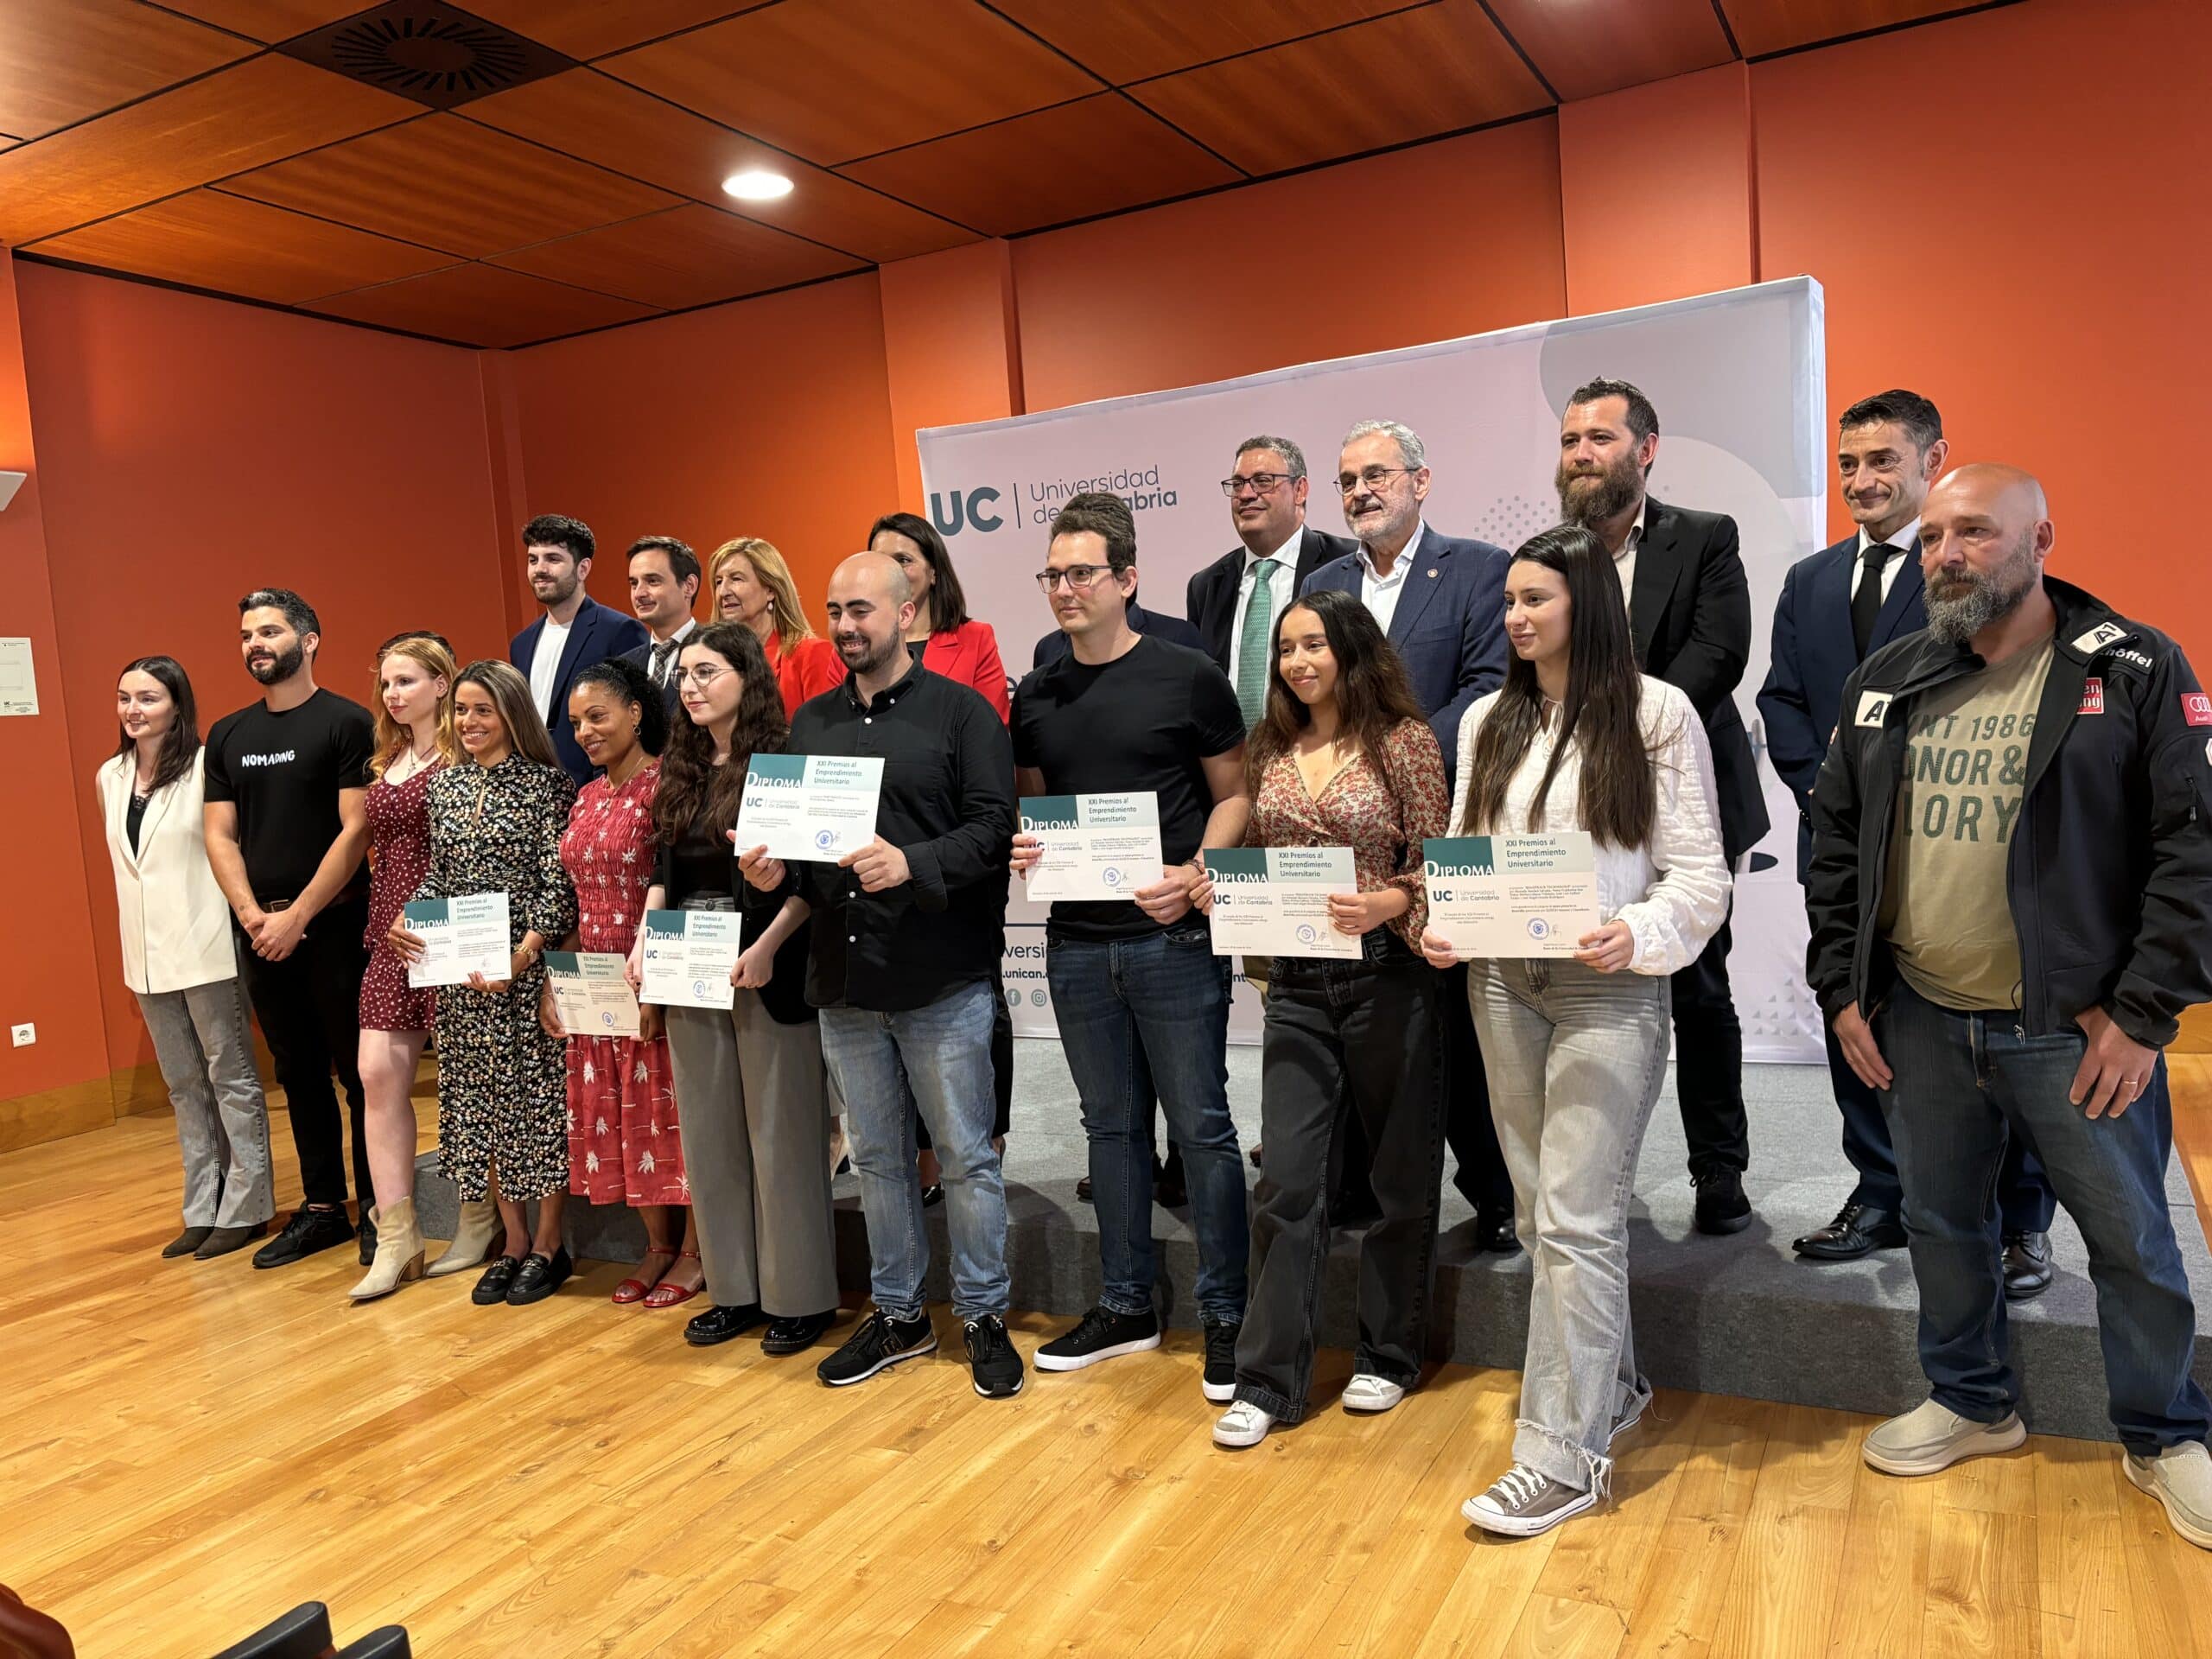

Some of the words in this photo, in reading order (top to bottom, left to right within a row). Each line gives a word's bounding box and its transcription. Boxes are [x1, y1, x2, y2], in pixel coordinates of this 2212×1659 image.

[1030, 465, 1159, 502] Universidad
[931, 486, 1003, 537] UC
[1971, 714, 2037, 741] 1986
[242, 749, 296, 767] NOMADING
[1999, 745, 2026, 785] &
[747, 772, 802, 788] DIPLOMA
[747, 797, 763, 807] UC
[1089, 806, 1137, 815] Emprendimiento
[1020, 817, 1079, 830] DIPLOMA
[1507, 849, 1566, 858] Emprendimiento
[1205, 868, 1268, 883] DIPLOMA
[1424, 861, 1494, 877] DIPLOMA
[1213, 895, 1231, 905] UC
[1433, 890, 1452, 901] UC
[404, 918, 448, 930] DIPLOMA
[646, 926, 683, 940] DIPLOMA
[646, 950, 658, 959] UC
